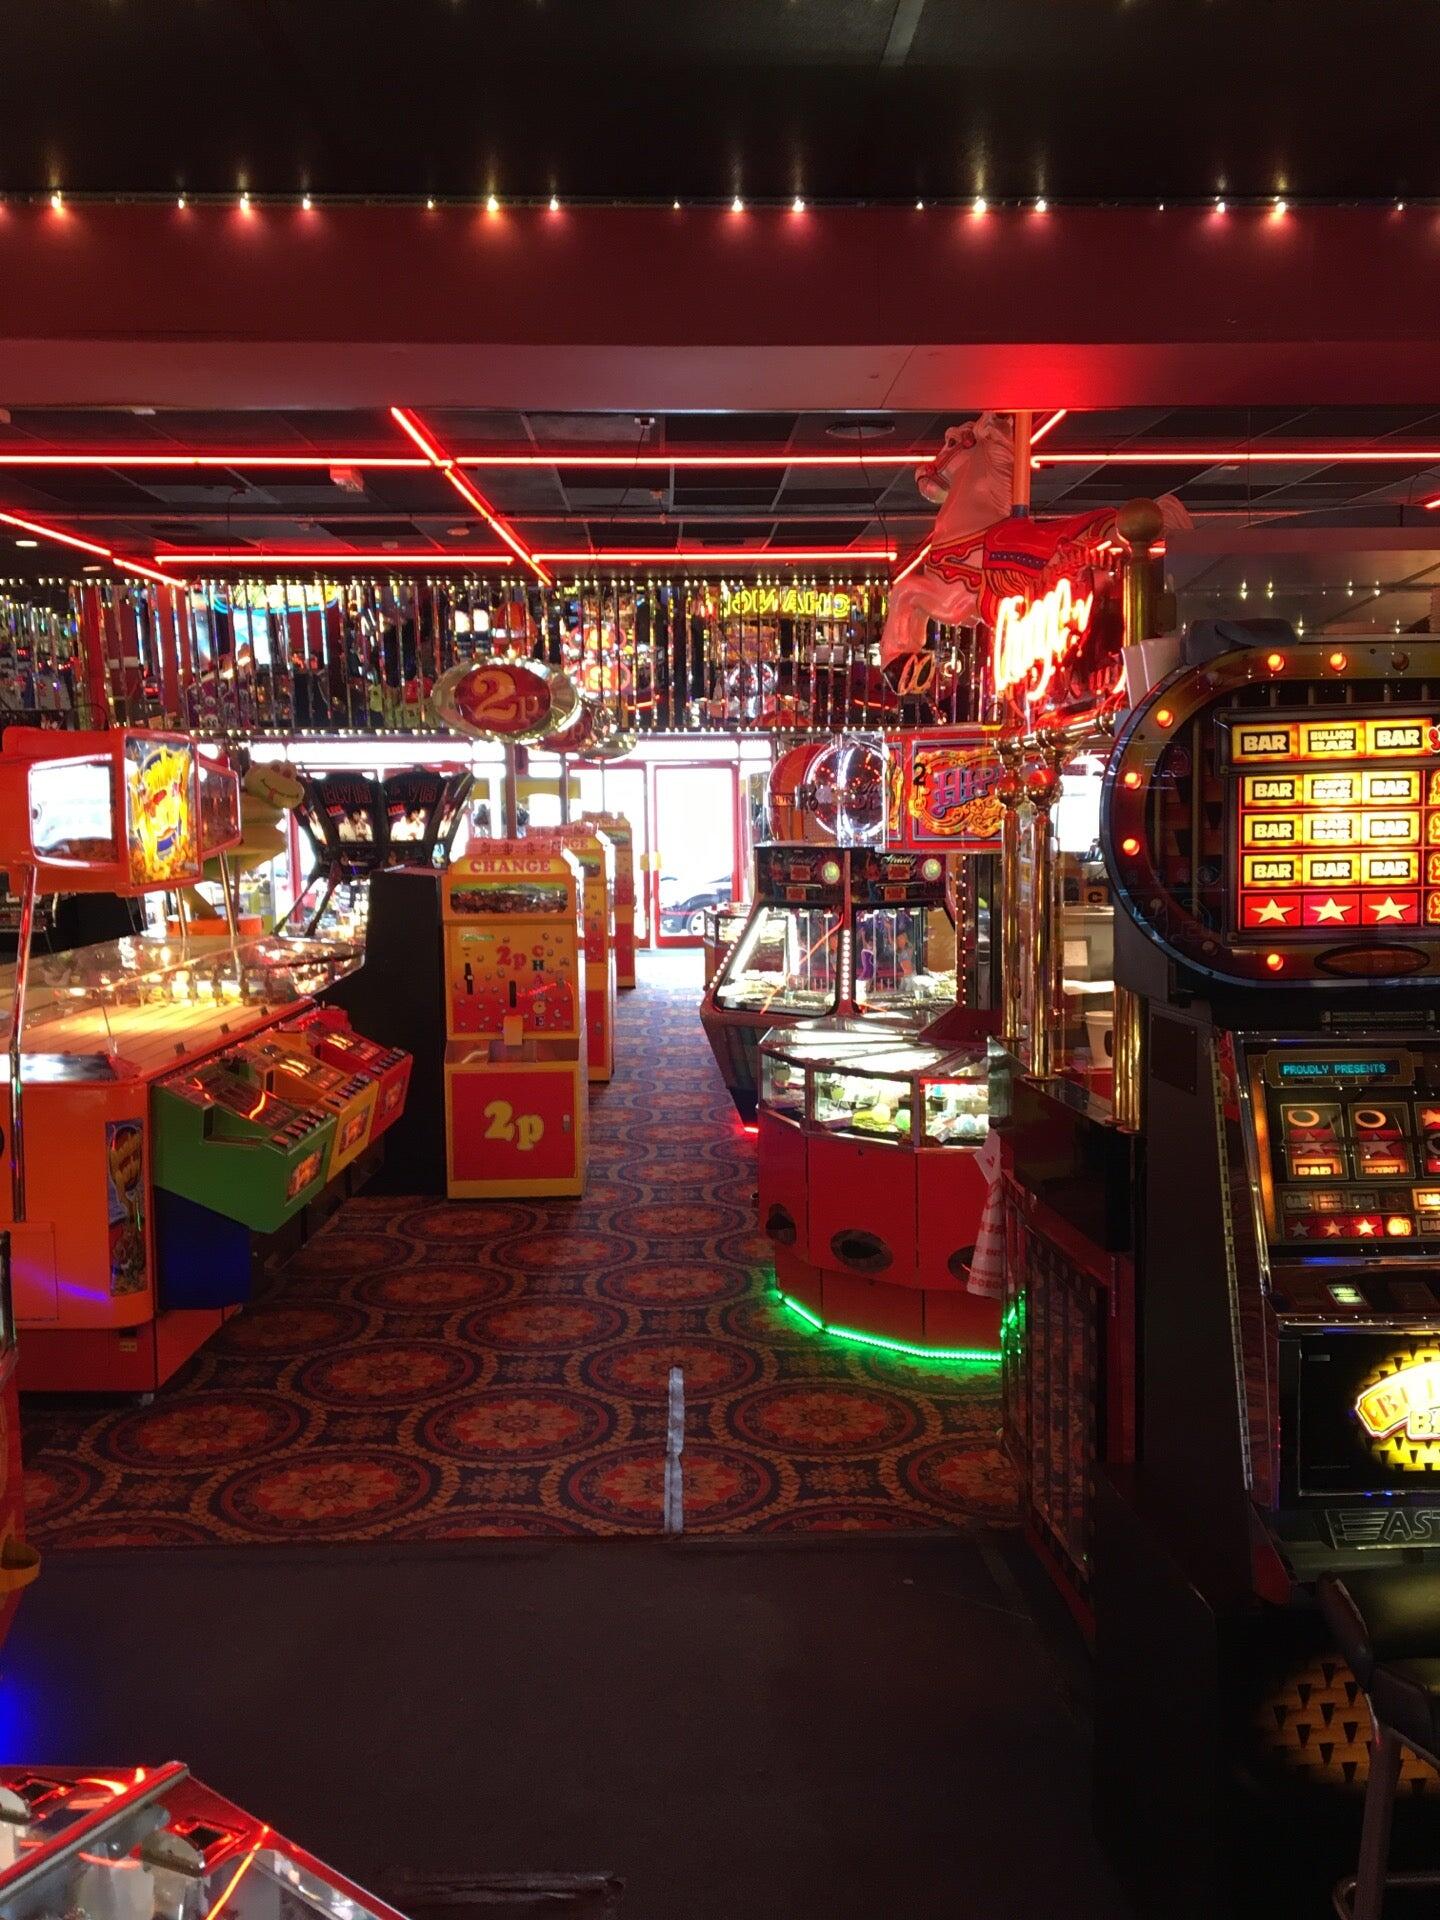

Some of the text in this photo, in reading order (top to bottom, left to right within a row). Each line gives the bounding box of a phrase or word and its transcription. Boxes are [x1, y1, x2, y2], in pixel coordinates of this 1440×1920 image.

[472, 670, 540, 724] 2p
[1243, 734, 1288, 751] BAR
[1310, 729, 1354, 741] BULLION
[1376, 729, 1420, 747] BAR
[1310, 740, 1354, 751] BAR
[1254, 783, 1293, 798] BAR
[1371, 780, 1410, 796] BAR
[1254, 823, 1293, 838] BAR
[1371, 820, 1409, 836] BAR
[469, 860, 551, 874] CHANGE
[1254, 863, 1293, 878] BAR
[1312, 862, 1351, 877] BAR
[1371, 861, 1409, 876] BAR
[496, 945, 527, 971] 2p
[1283, 1063, 1386, 1075] PROUDLY PRESENTS
[484, 1099, 545, 1151] 2p
